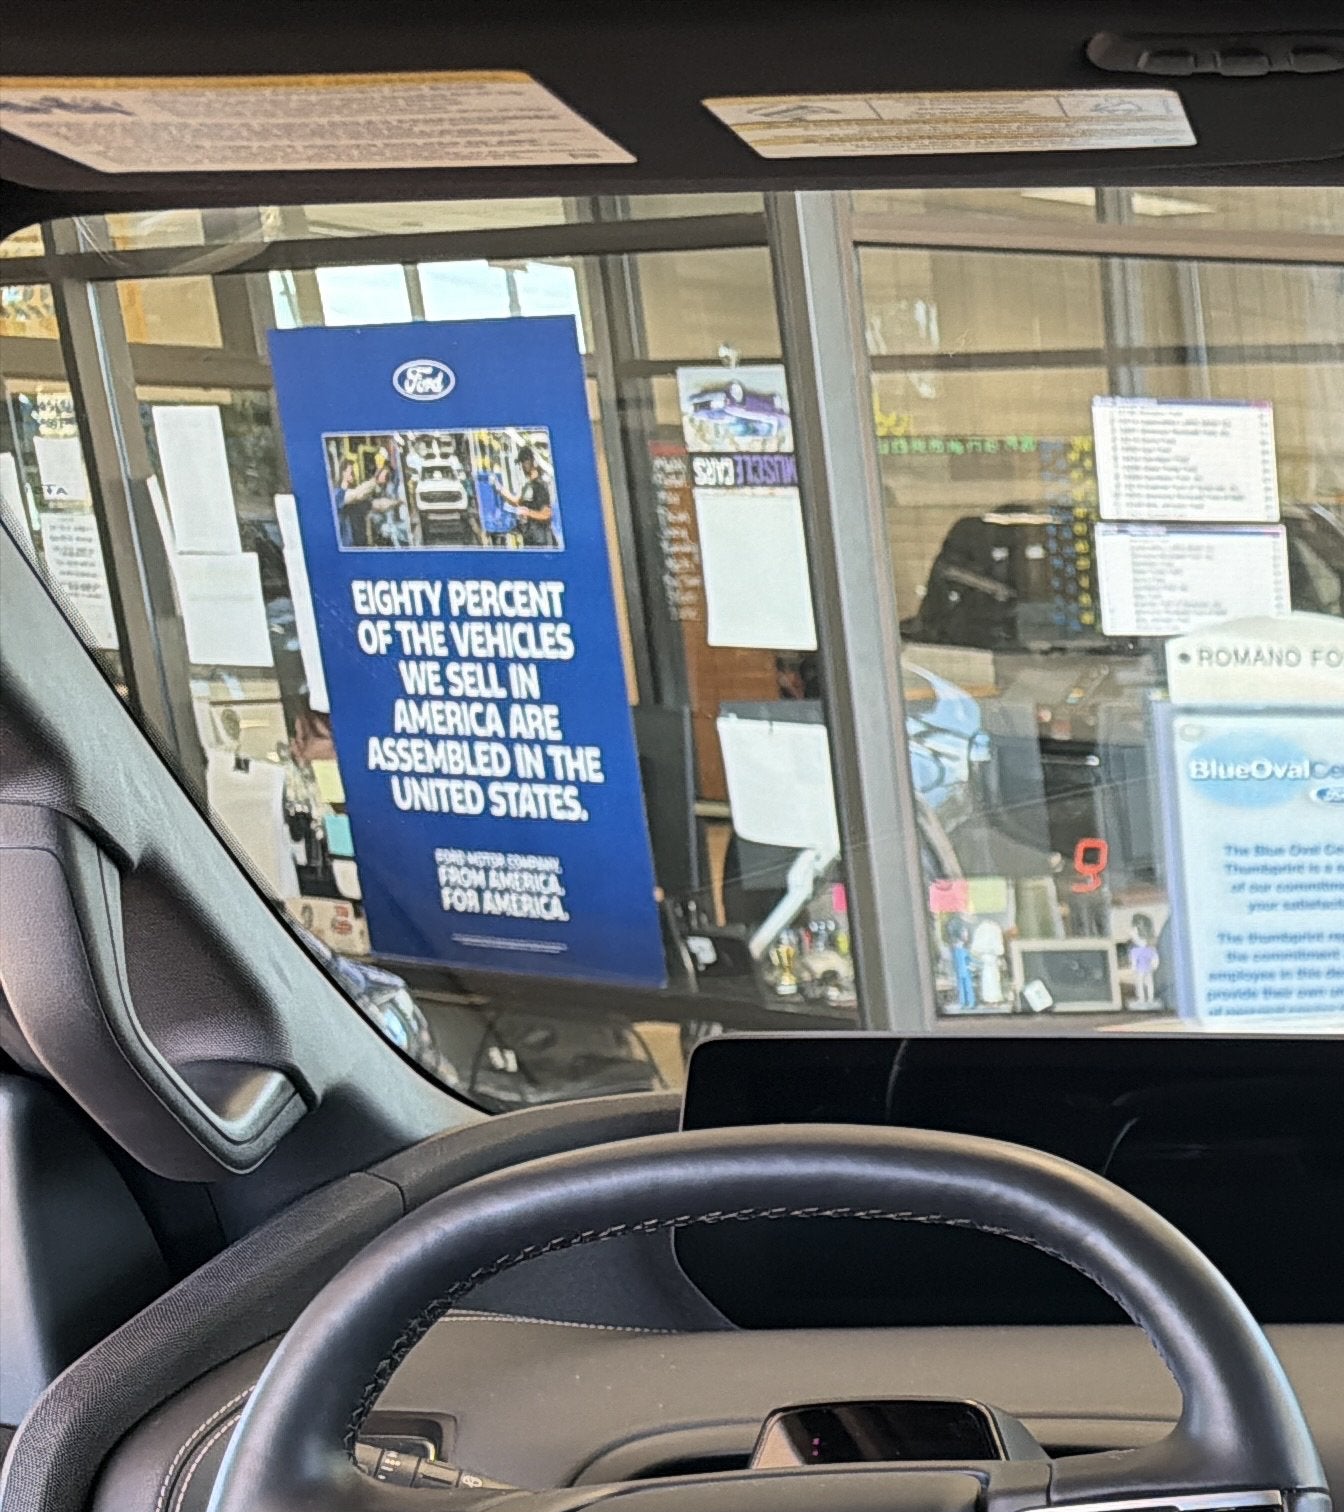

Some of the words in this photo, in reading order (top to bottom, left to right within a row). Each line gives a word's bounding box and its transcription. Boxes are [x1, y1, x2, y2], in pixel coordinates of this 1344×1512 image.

[404, 366, 444, 394] Ford
[693, 456, 735, 486] CARS
[351, 580, 442, 616] EIGHTY
[447, 580, 565, 618] PERCENT
[358, 619, 392, 655] OF
[395, 620, 449, 657] THE
[449, 621, 575, 660] VEHICLES
[1198, 648, 1302, 668] ROMANO
[398, 659, 445, 696] WE
[445, 661, 508, 698] SELL
[508, 662, 541, 699] IN
[394, 698, 506, 738] AMERICA
[509, 703, 563, 741] ARE
[368, 736, 511, 777] ASSEMBLED
[513, 742, 546, 779] IN
[546, 744, 605, 783] THE
[391, 775, 485, 815] UNITED
[487, 780, 589, 822] STATES.
[438, 864, 486, 889] FROM
[488, 868, 566, 896] AMERICA.
[441, 888, 480, 913] FOR
[483, 889, 570, 921] AMERICA.
